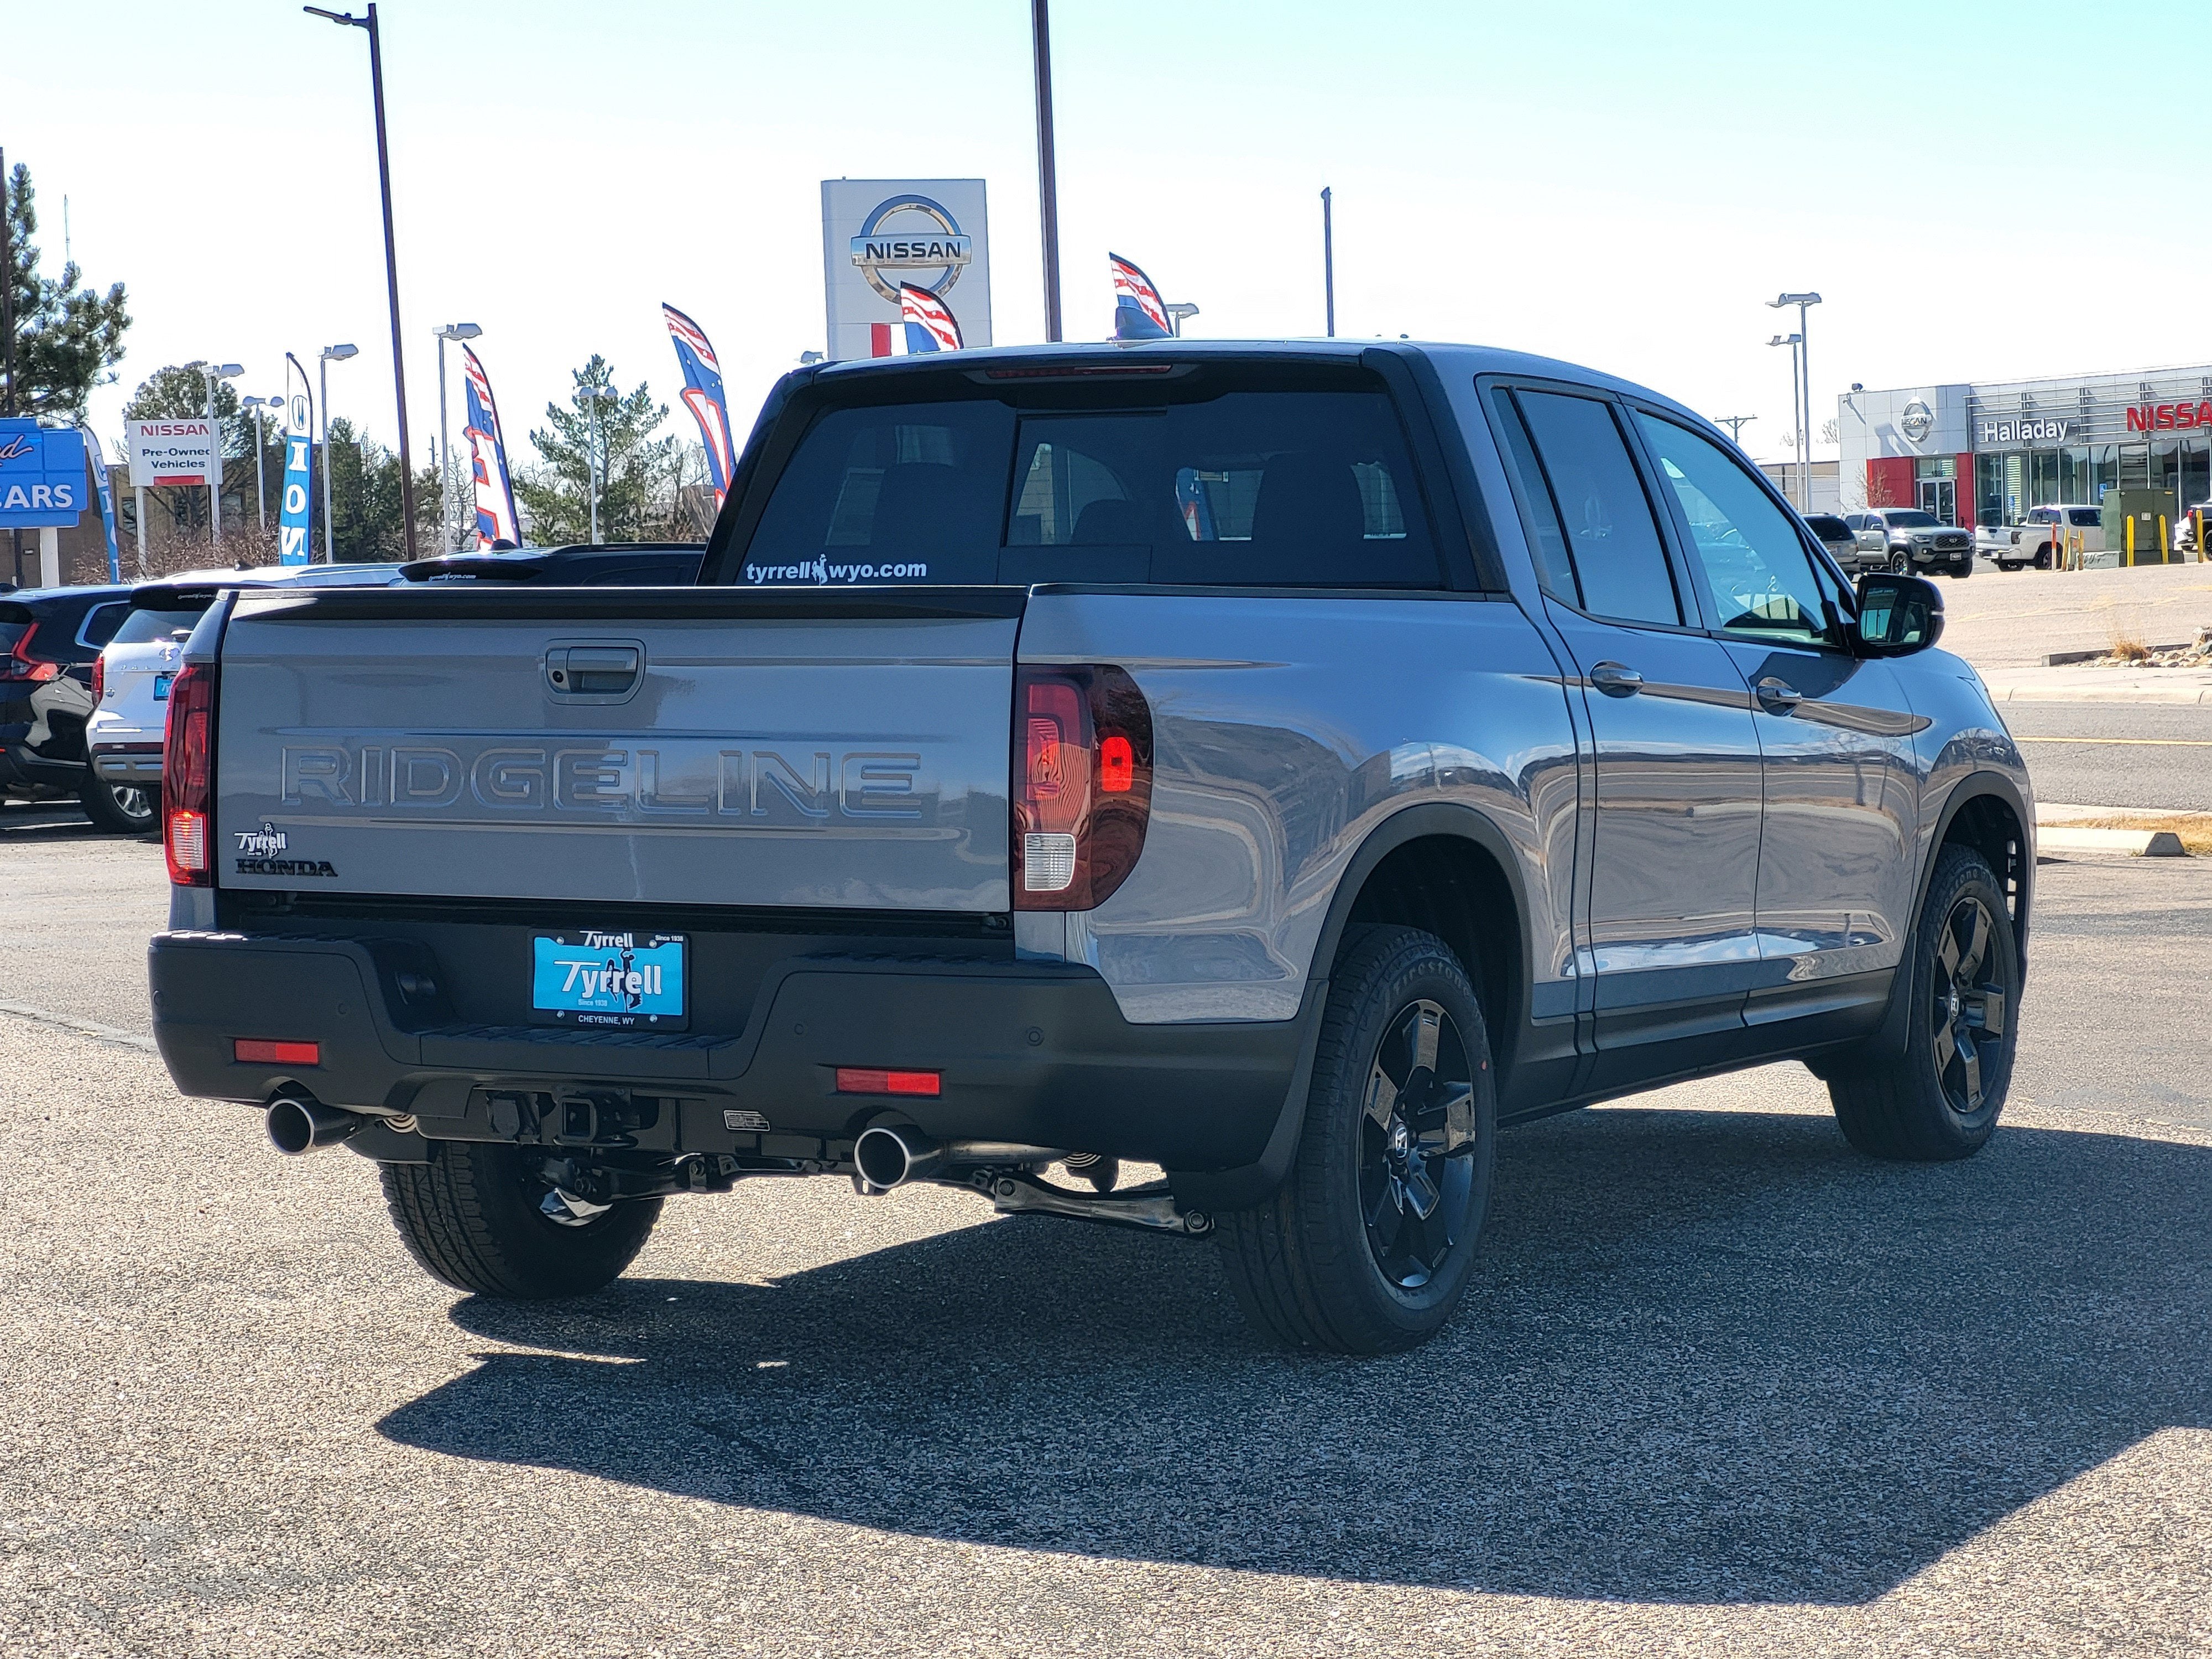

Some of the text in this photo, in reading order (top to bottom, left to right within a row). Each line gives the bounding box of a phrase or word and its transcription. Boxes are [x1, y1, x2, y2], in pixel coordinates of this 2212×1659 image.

[865, 242, 961, 259] NISSAN
[2126, 402, 2212, 432] NISSA
[140, 424, 209, 436] NISSAN
[1984, 418, 2068, 442] Halladay
[151, 460, 206, 468] Vehicles
[0, 485, 73, 508] ARS
[280, 745, 922, 818] RIDGELINE
[234, 832, 286, 852] Tyrrell
[236, 859, 338, 877] HONDA
[579, 931, 633, 950] Tyrrell
[554, 961, 662, 998] Tyrrell
[1393, 961, 1470, 998] Firestone
[578, 1015, 620, 1025] CHEYENNE,
